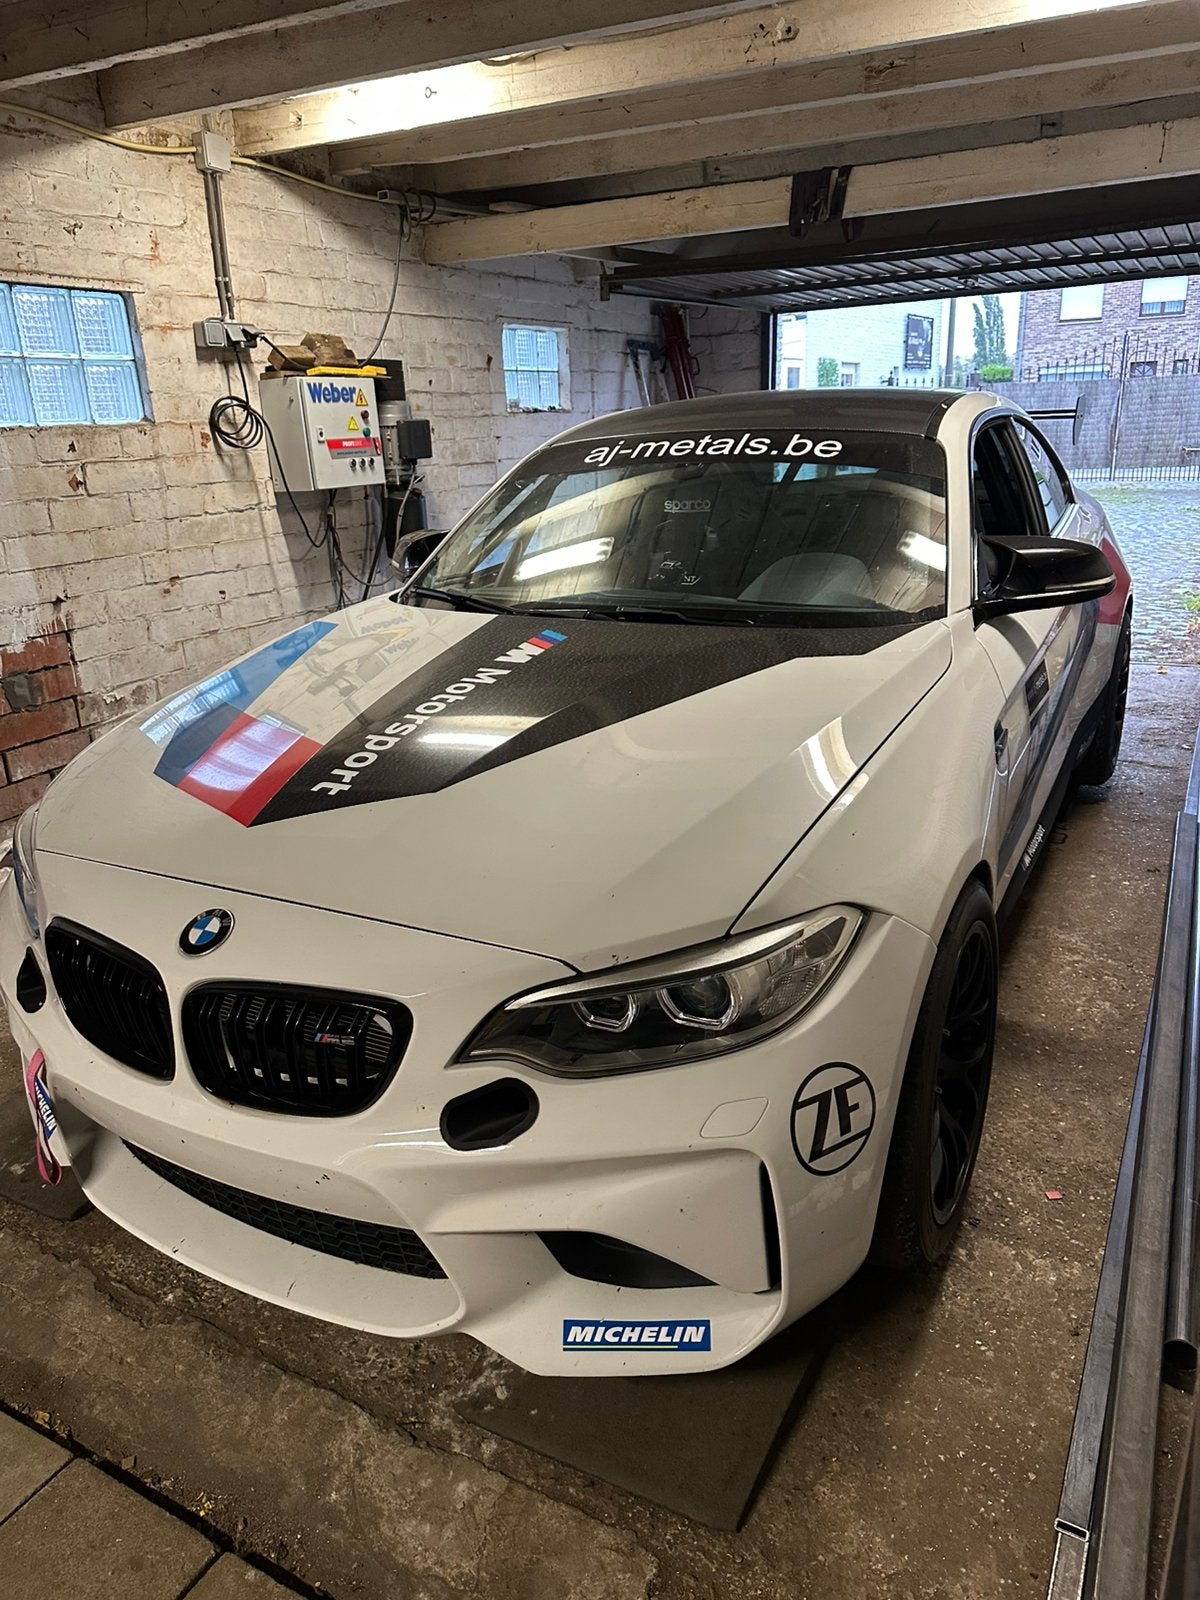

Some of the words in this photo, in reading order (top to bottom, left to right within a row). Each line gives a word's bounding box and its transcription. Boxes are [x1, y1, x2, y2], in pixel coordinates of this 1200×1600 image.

[306, 382, 357, 403] Weber
[584, 433, 843, 467] aj-metals.be
[664, 499, 711, 513] sparco
[311, 667, 512, 796] Motorsport
[1026, 823, 1046, 858] Motorsport
[794, 1076, 872, 1164] ZF
[566, 1326, 706, 1343] MICHELIN
